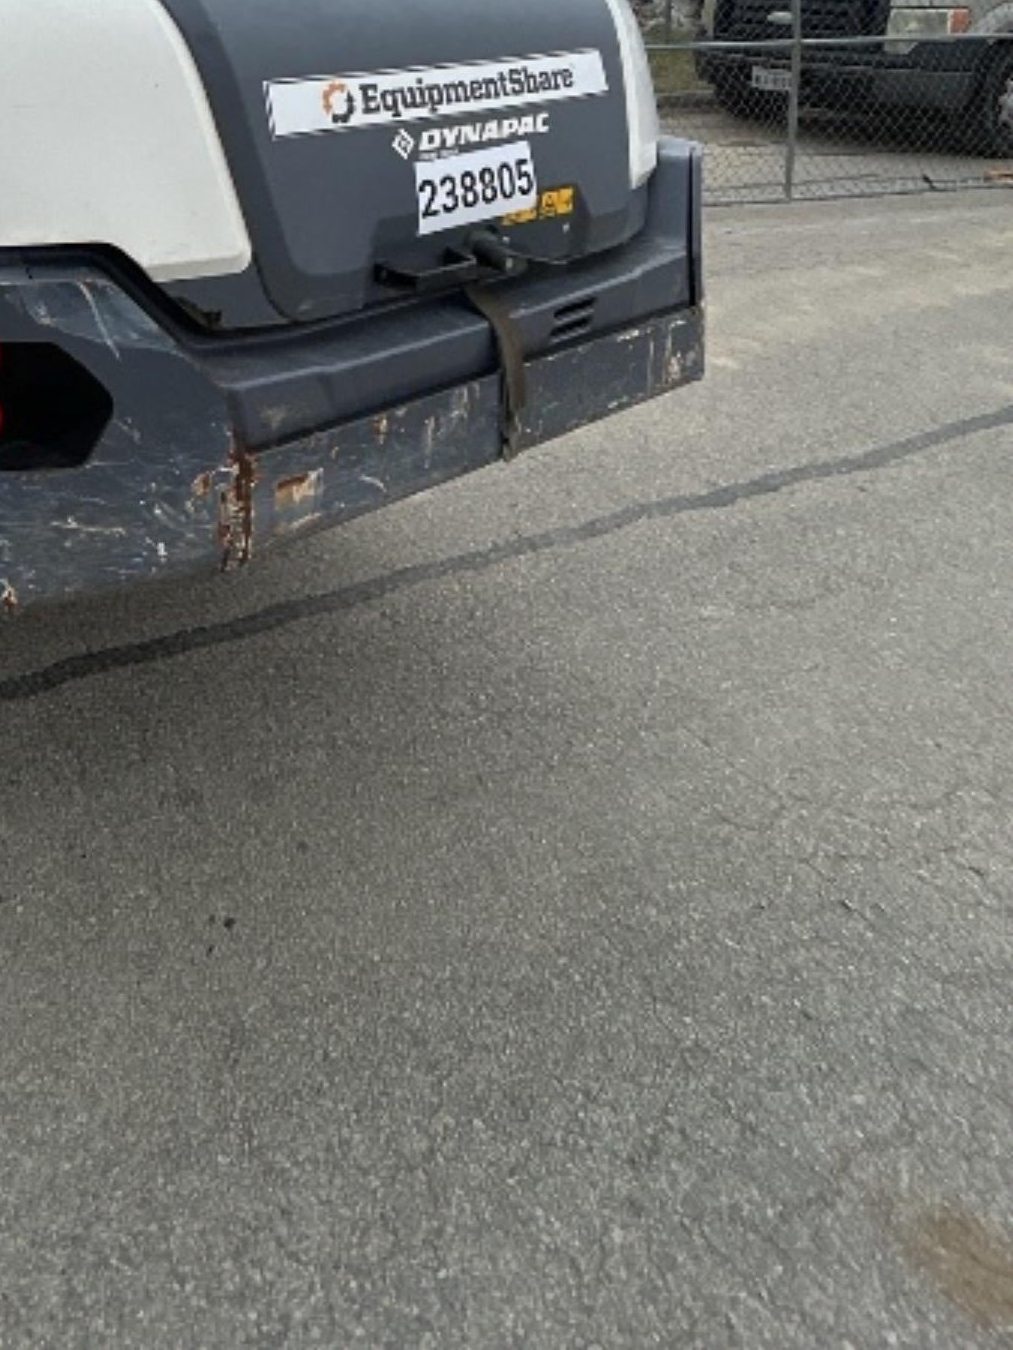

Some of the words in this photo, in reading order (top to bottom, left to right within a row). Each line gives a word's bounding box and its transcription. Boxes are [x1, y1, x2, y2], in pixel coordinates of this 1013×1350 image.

[359, 66, 574, 118] EquipmentShare
[418, 112, 549, 151] DYNAPAC
[418, 158, 534, 220] 238805
